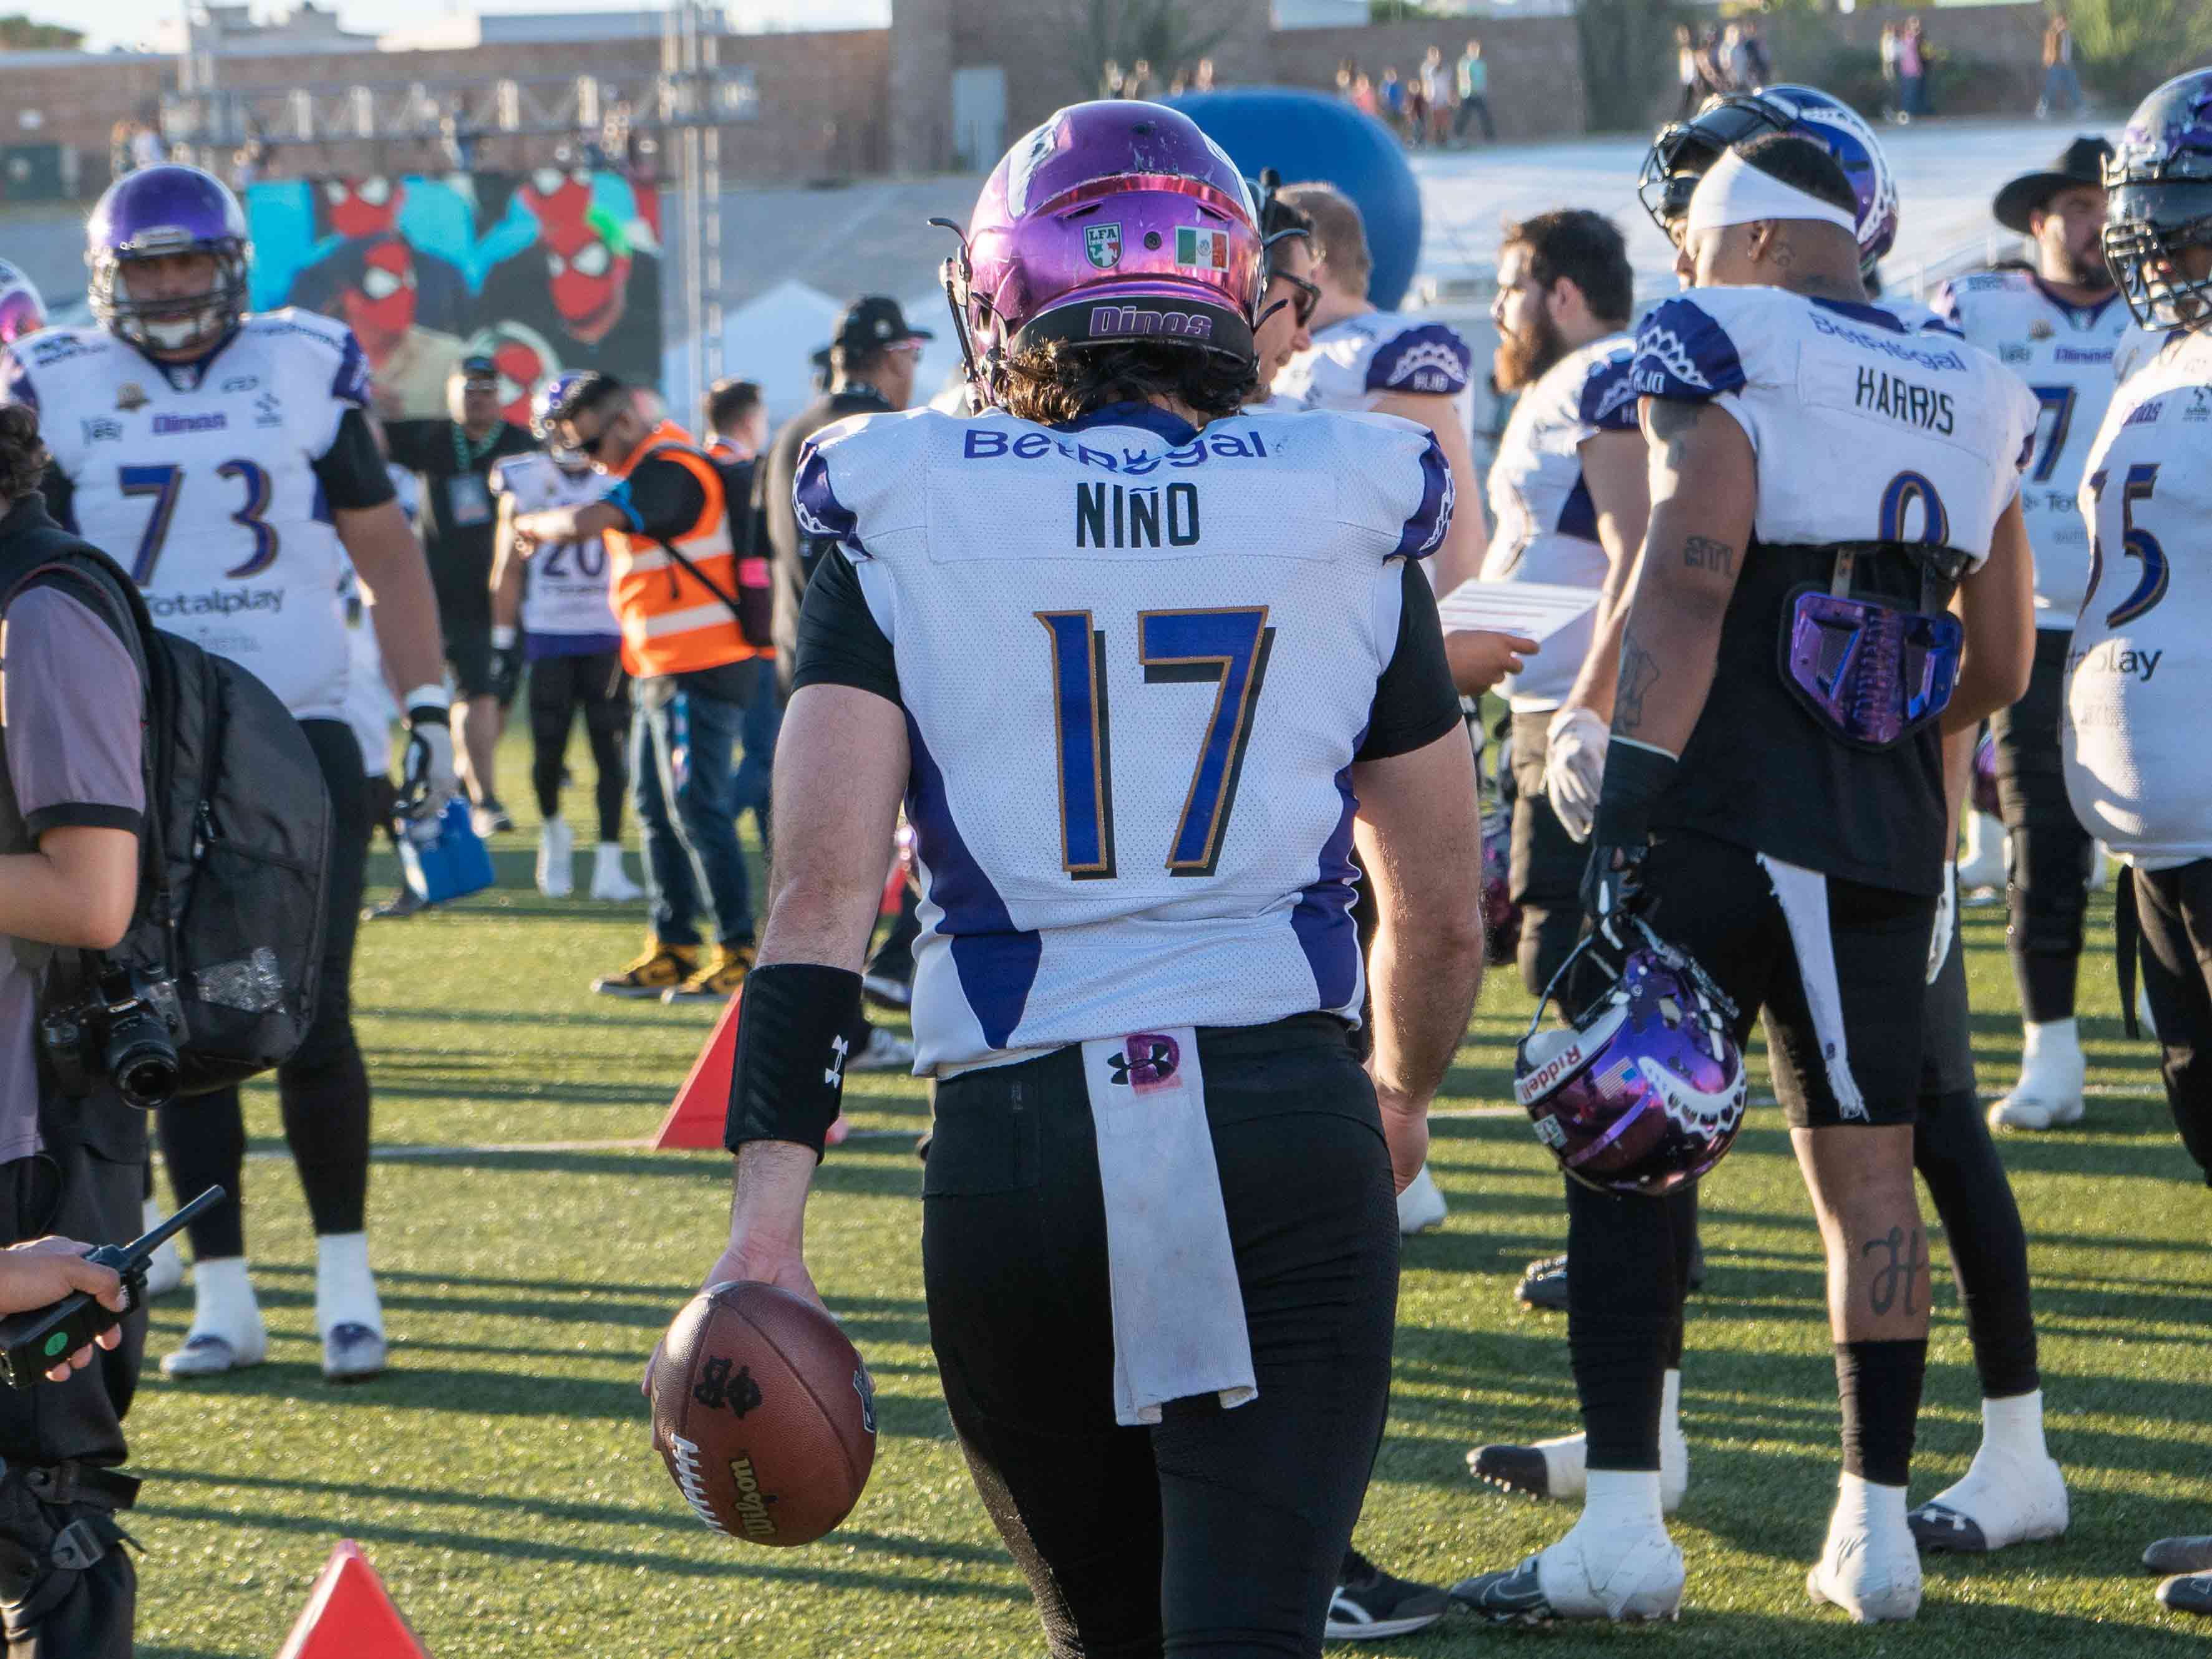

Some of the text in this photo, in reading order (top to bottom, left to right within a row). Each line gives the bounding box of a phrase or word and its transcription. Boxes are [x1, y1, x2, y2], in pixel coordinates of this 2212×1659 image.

[1088, 228, 1117, 241] LFA
[1090, 305, 1213, 340] Dinos
[1855, 365, 1955, 436] HARRIS
[118, 458, 279, 586] 73
[1076, 481, 1200, 548] NIÑO
[1032, 604, 1277, 881] 17
[1521, 1044, 1582, 1100] Riddell
